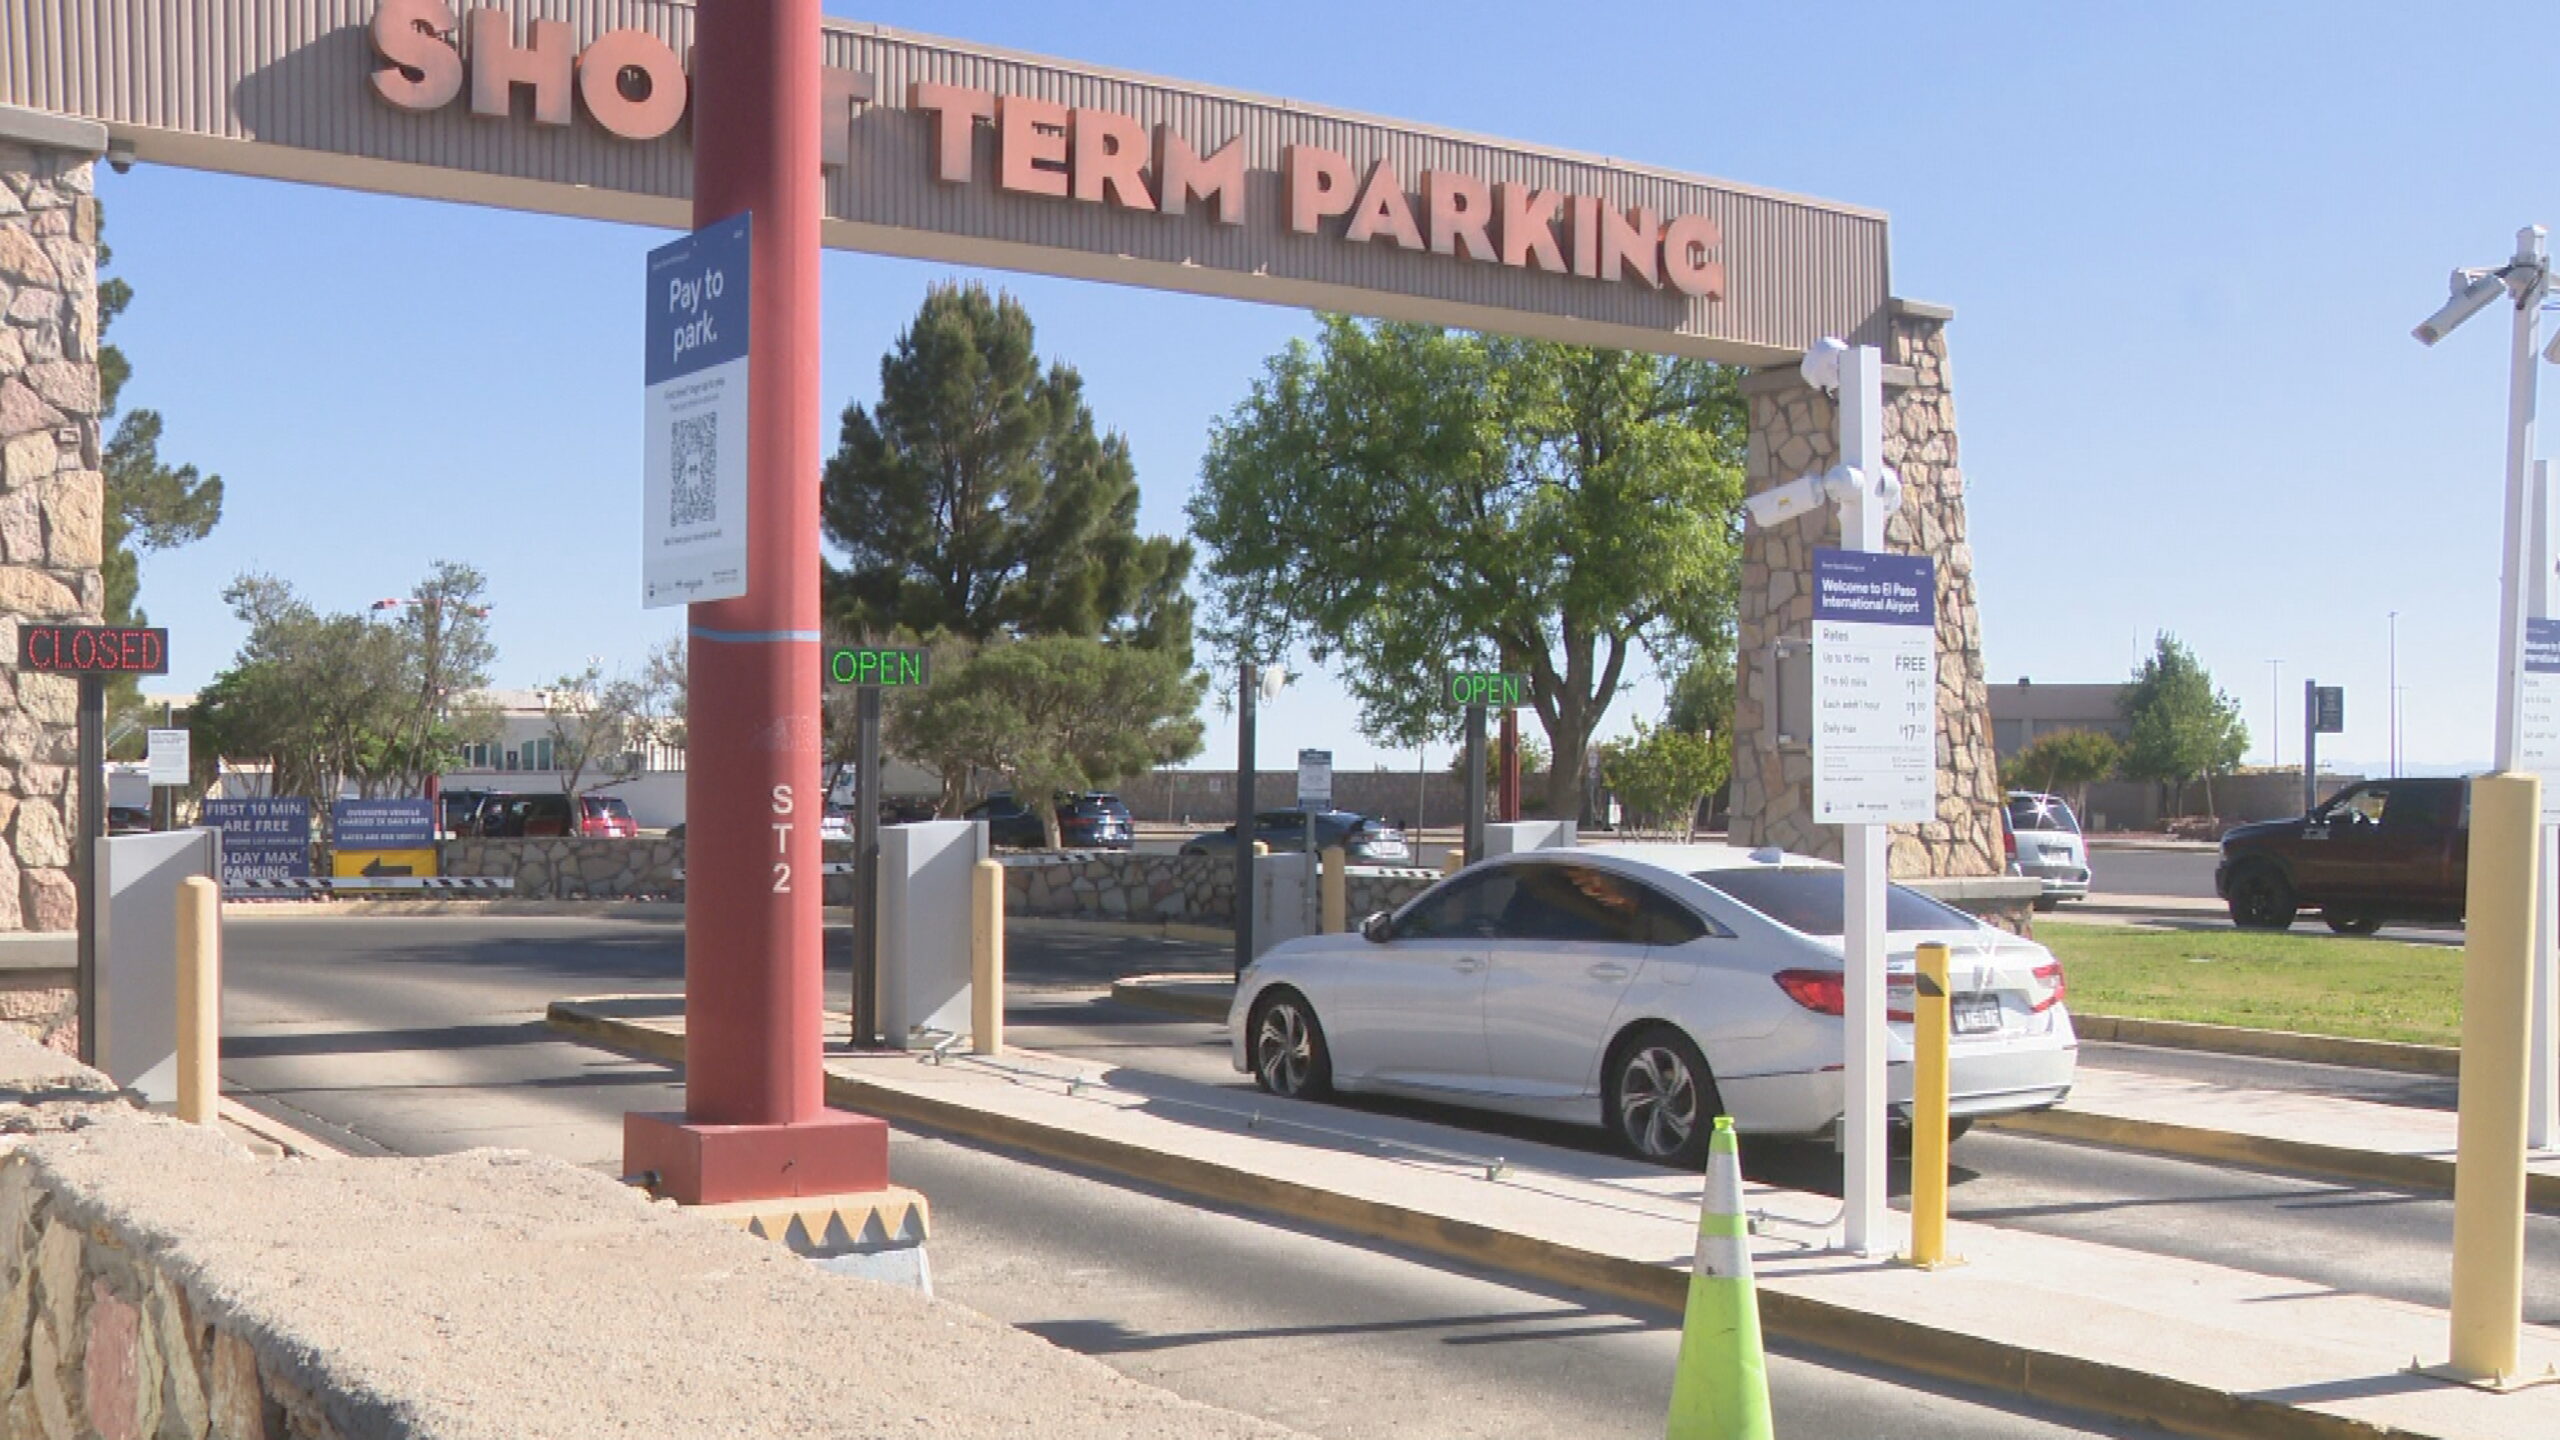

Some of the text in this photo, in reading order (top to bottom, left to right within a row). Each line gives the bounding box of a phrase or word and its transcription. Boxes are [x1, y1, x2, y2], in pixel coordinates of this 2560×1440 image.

[370, 0, 1723, 301] SHOT TERM PARKING
[669, 266, 724, 316] Pay to
[673, 309, 718, 365] park.
[1822, 577, 1917, 597] Welcome to El Paso
[1822, 593, 1920, 615] International Airport
[1823, 628, 1849, 642] Rates
[28, 626, 161, 669] CLOSED
[832, 651, 921, 685] OPEN
[1895, 655, 1926, 672] FREE
[1452, 672, 1520, 705] OPEN
[207, 804, 245, 816] FIRST
[251, 804, 267, 816] 10
[223, 820, 289, 832] ARE FREE
[231, 852, 261, 864] DAY
[265, 852, 302, 864] MAX.
[223, 866, 289, 878] PARKING
